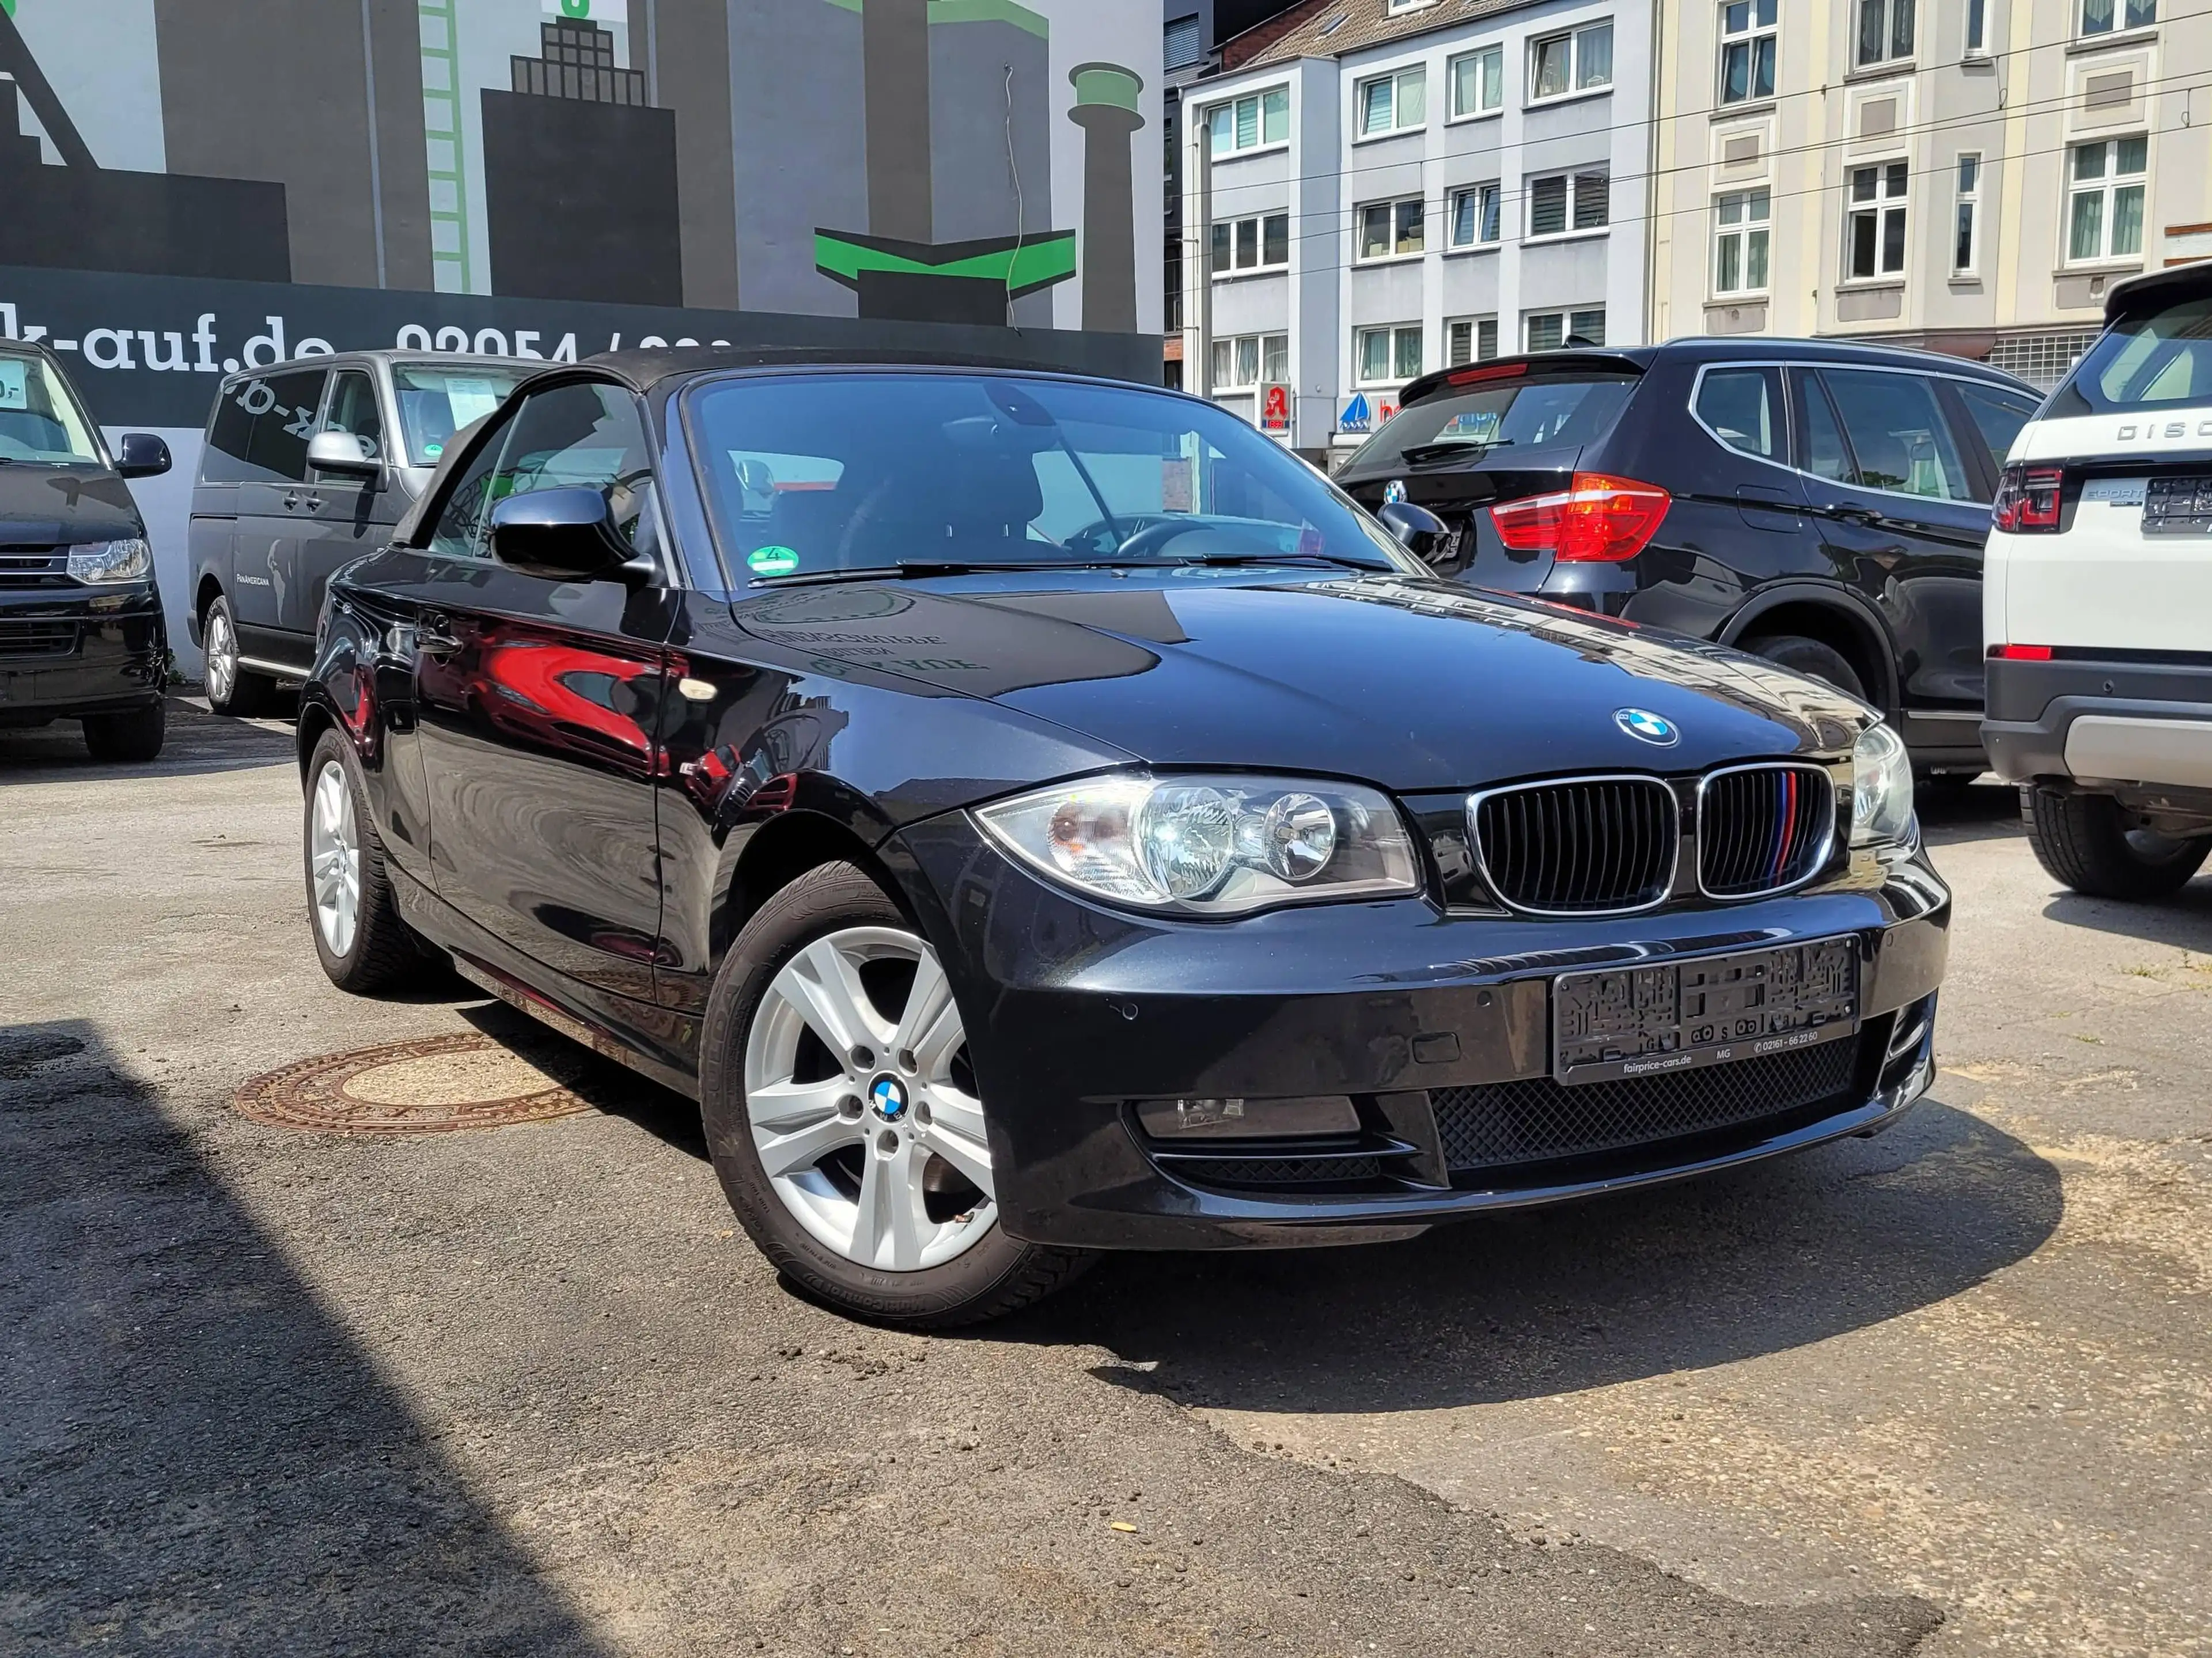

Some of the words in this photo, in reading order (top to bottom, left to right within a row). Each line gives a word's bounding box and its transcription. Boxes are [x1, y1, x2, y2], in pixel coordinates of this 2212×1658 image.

[766, 548, 781, 560] 4
[1623, 1055, 1692, 1075] fairprice-cars.de
[1716, 1048, 1730, 1060] MG
[1763, 1038, 1783, 1051] 02161
